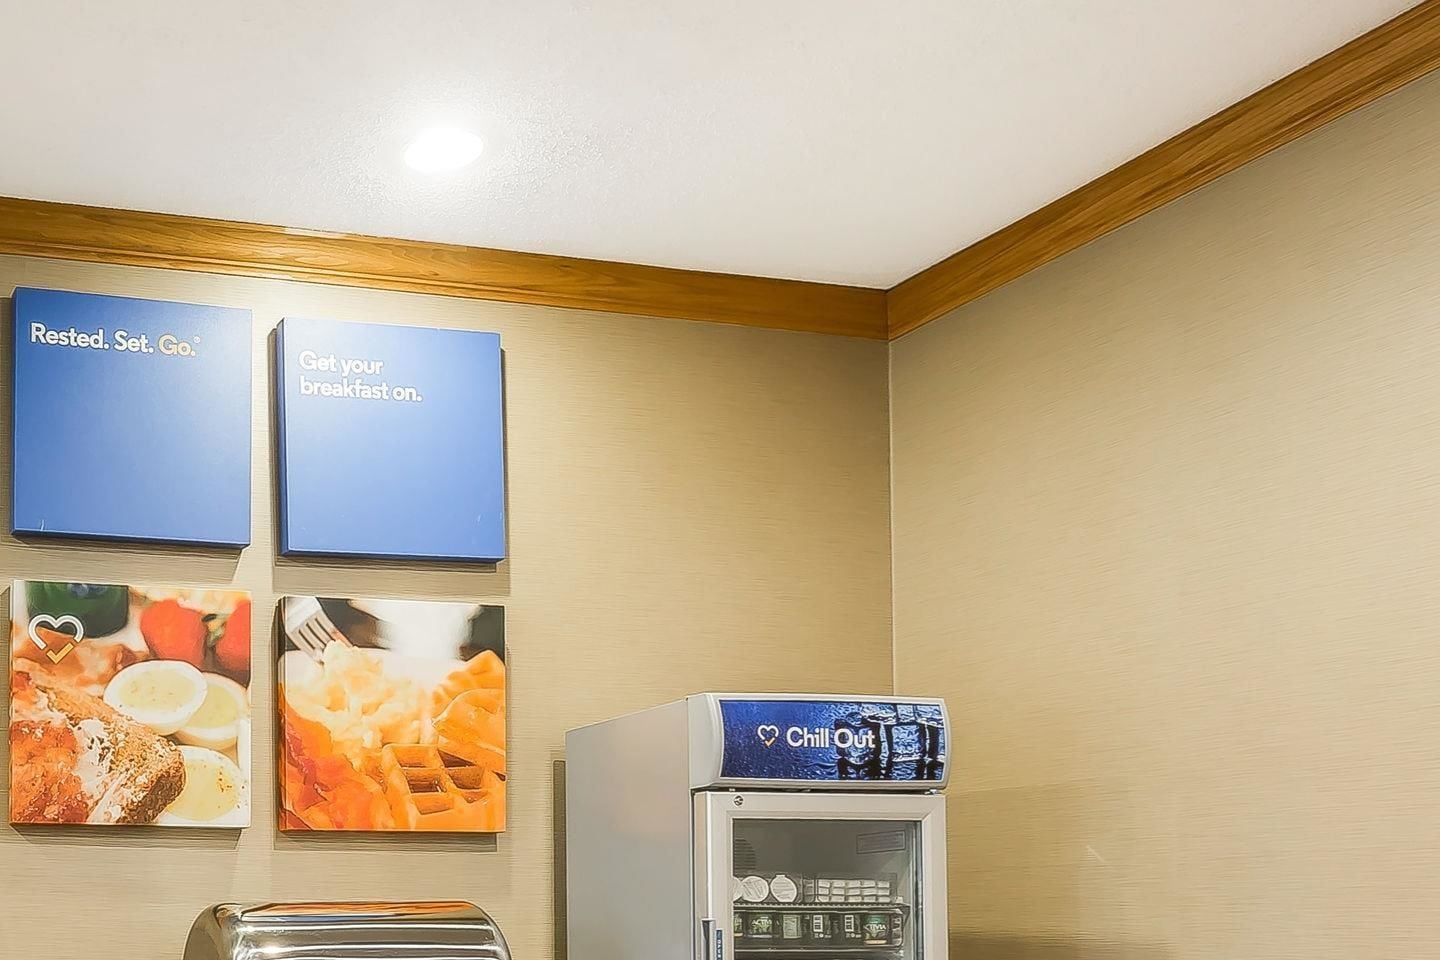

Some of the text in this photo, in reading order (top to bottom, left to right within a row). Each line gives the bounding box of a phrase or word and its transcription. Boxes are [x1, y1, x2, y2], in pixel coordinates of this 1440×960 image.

[30, 322, 110, 350] Rested.
[114, 330, 155, 353] Set.
[298, 350, 384, 377] Get your
[298, 375, 423, 402] breakfast on.
[786, 726, 876, 749] Chill Out
